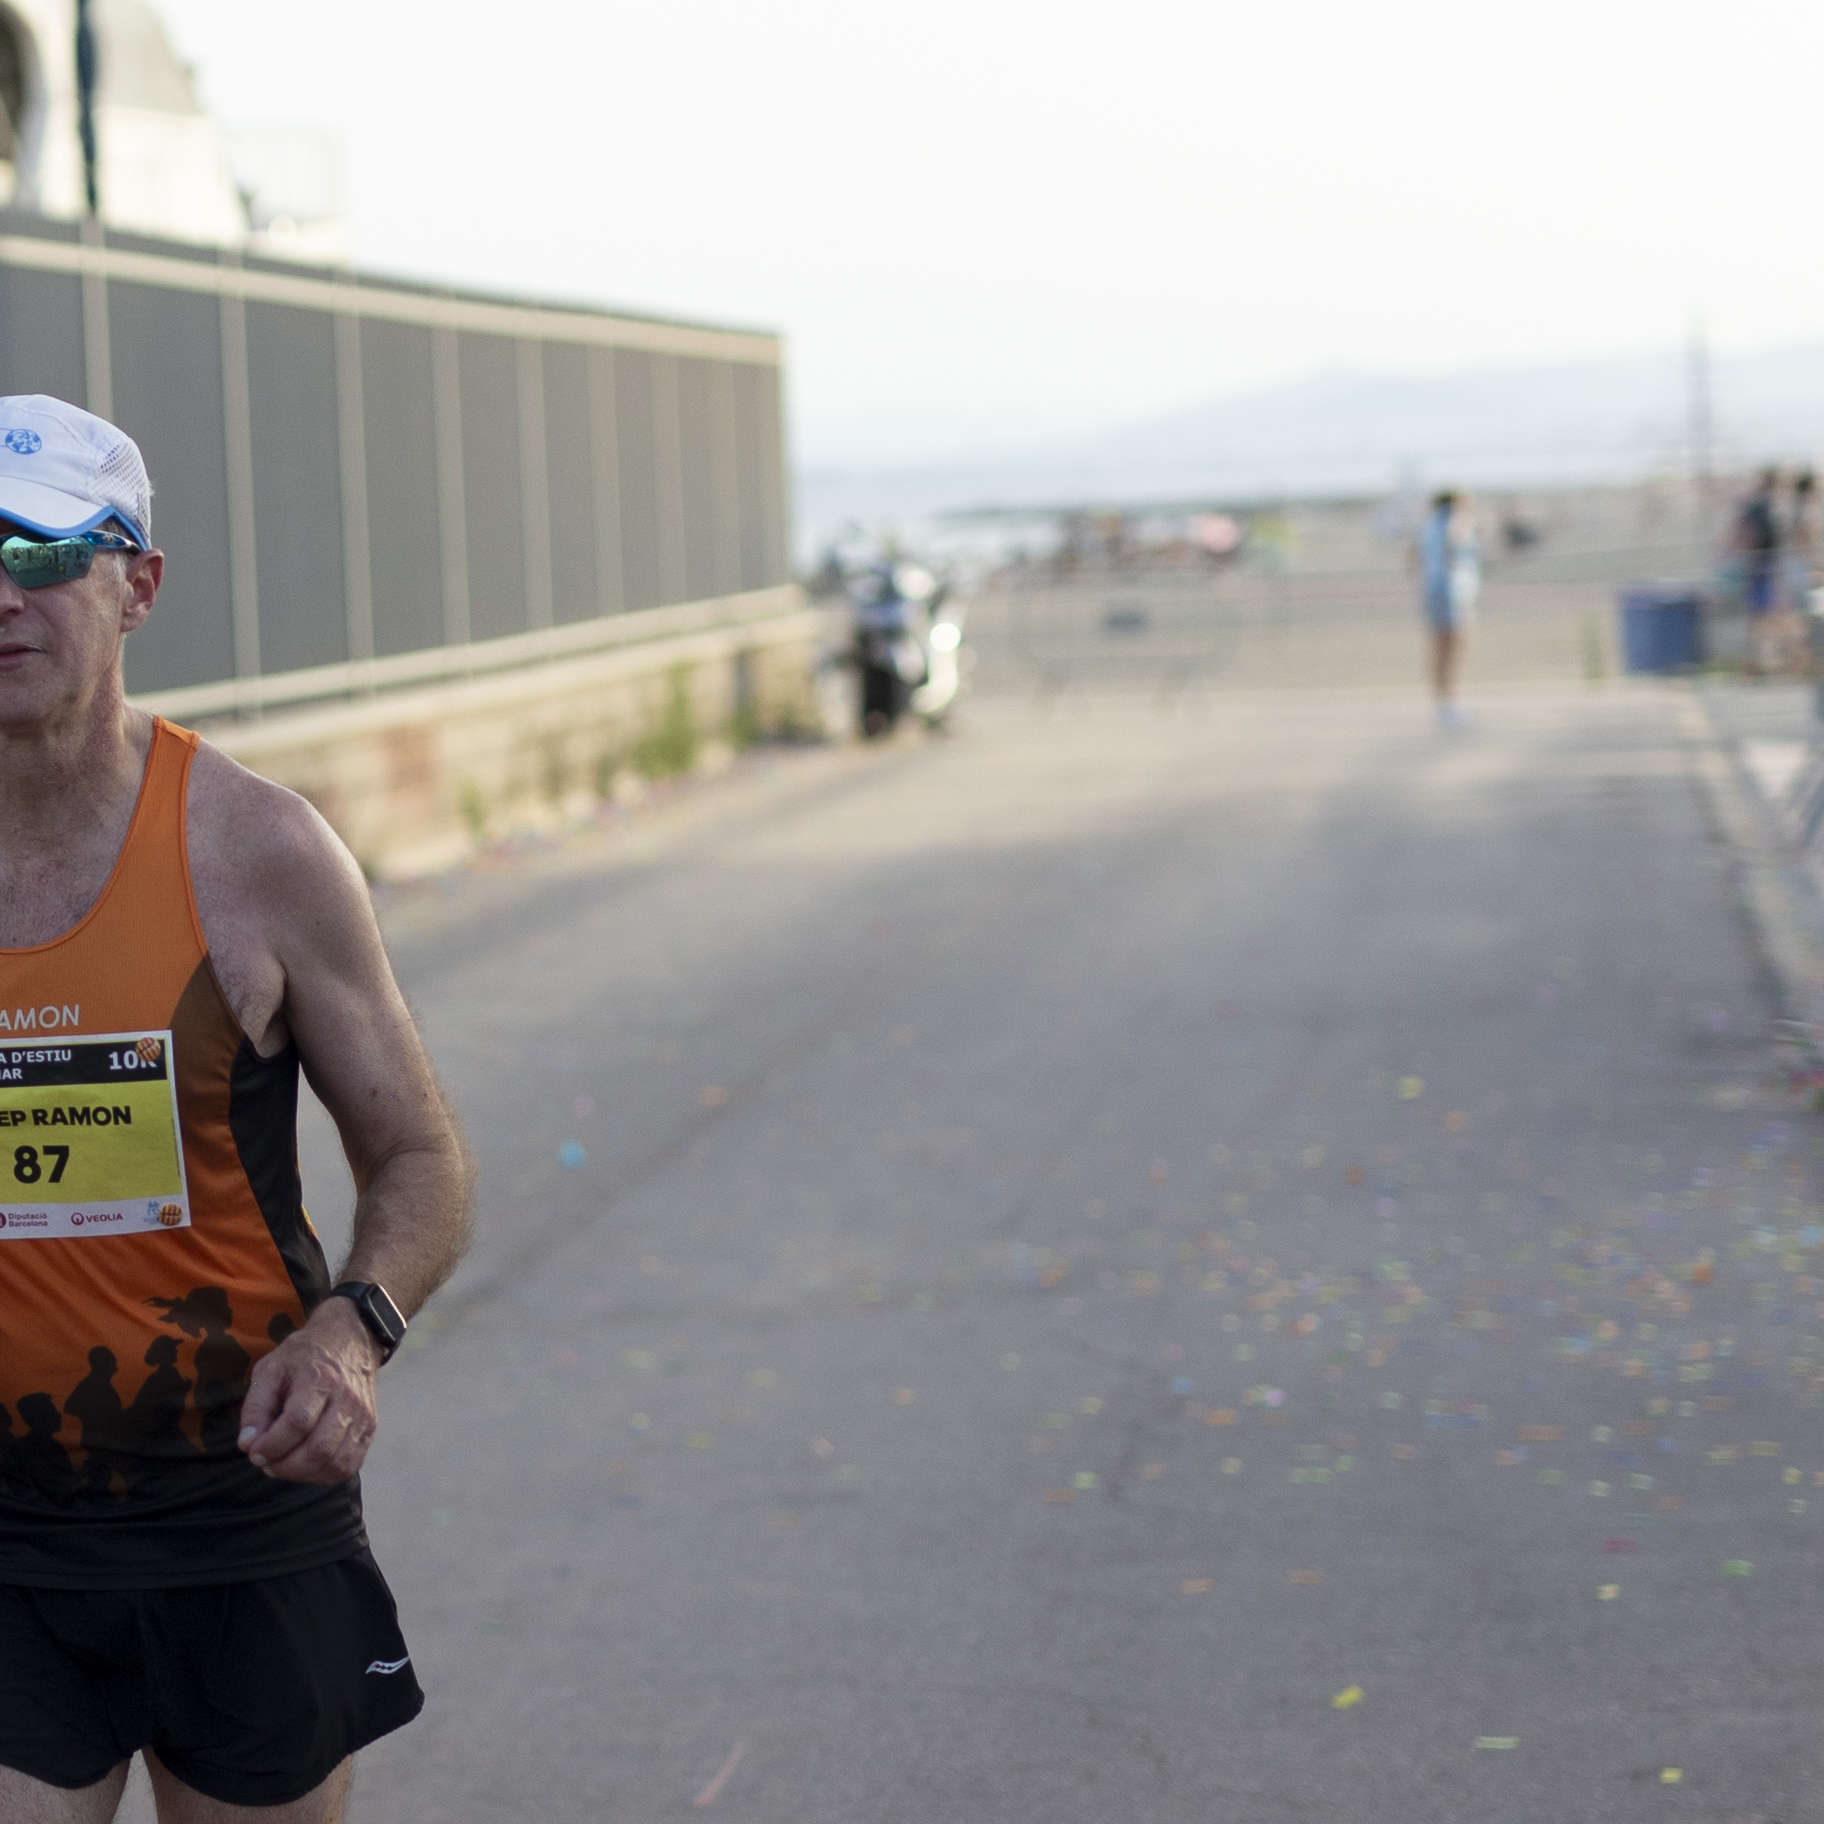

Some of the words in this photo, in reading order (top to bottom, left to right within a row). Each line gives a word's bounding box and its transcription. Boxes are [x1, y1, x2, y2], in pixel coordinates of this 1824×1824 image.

[12, 1049, 72, 1063] D'ESTIU
[31, 1105, 132, 1126] RAMON
[13, 1145, 70, 1184] 87
[8, 1212, 47, 1220] Diputació
[86, 1213, 123, 1223] VEOLIA
[8, 1220, 48, 1228] Barcelona
